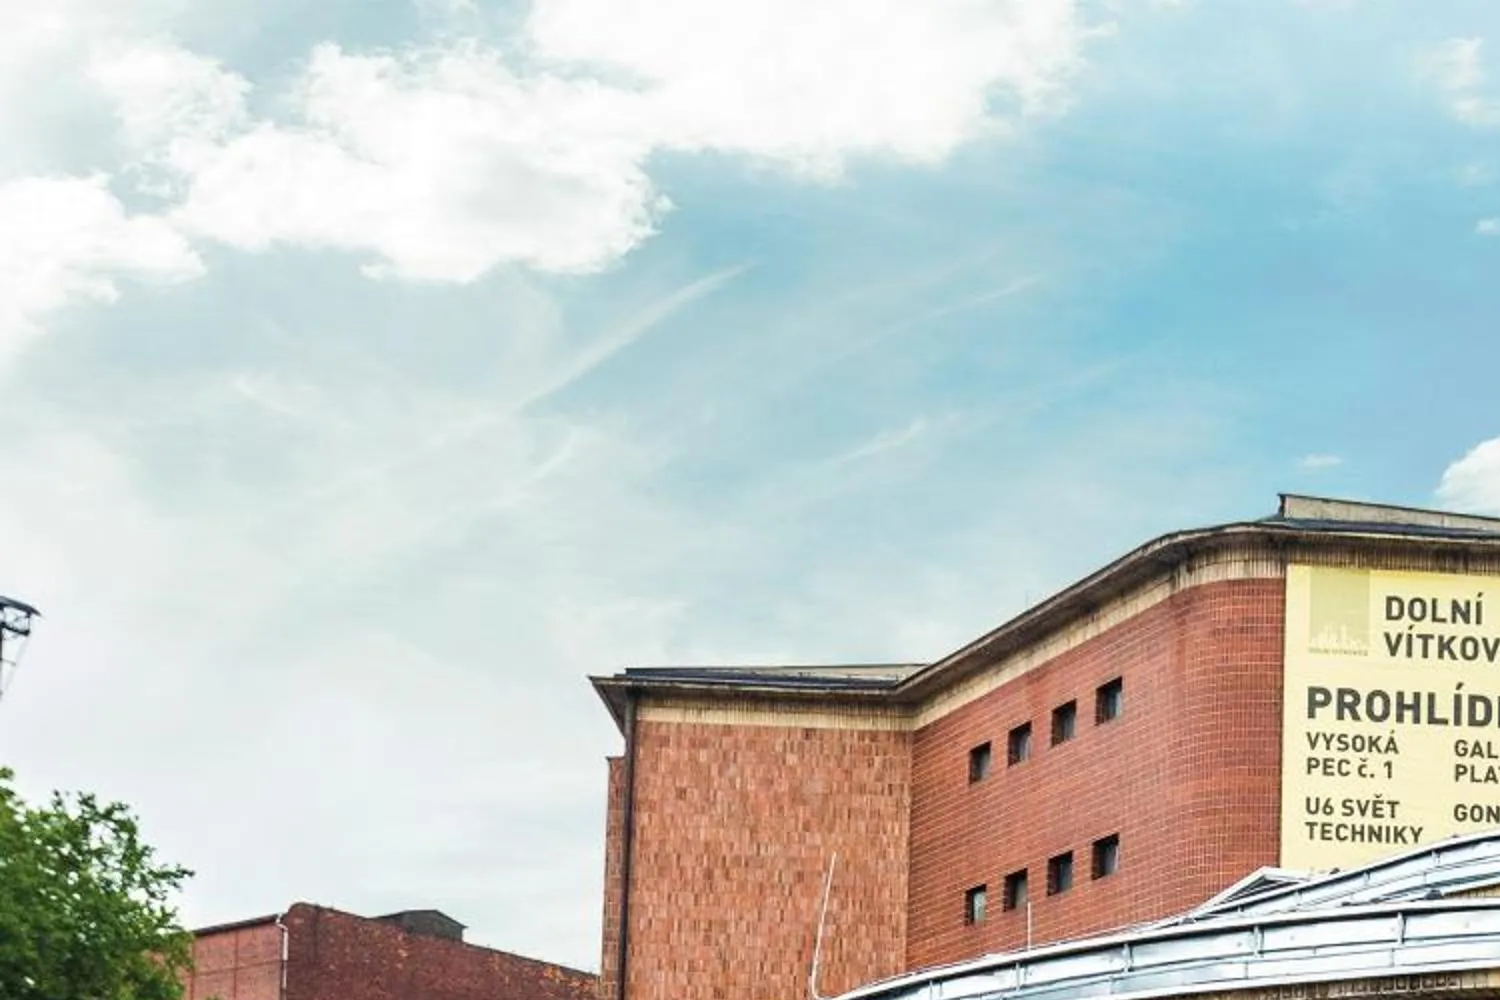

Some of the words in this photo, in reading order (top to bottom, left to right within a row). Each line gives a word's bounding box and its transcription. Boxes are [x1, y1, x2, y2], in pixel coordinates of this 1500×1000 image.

[1385, 592, 1484, 625] DOLNÍ
[1306, 730, 1399, 754] VYSOKÁ
[1306, 757, 1351, 777] PEC
[1383, 760, 1393, 780] 1
[1305, 796, 1335, 817] U6
[1341, 794, 1400, 820] SVĚT
[1305, 821, 1424, 845] TECHNIKY
